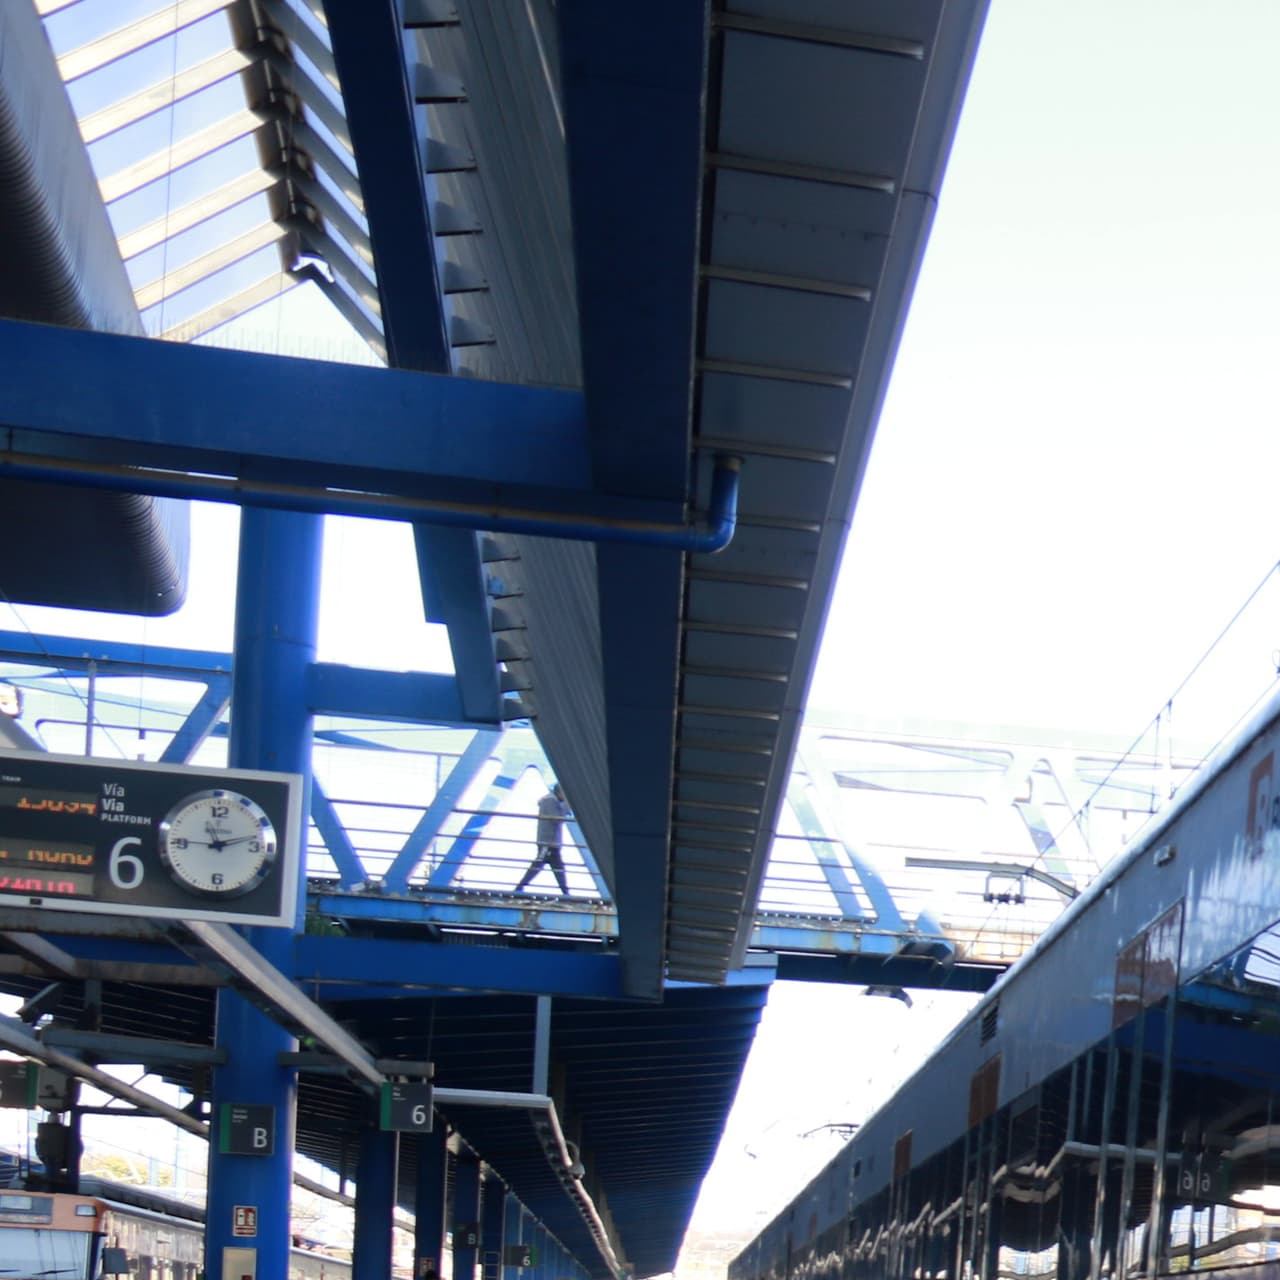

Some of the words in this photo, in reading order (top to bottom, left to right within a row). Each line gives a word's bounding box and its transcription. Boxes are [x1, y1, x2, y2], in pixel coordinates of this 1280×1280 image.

[101, 812, 152, 825] PLATFORM
[210, 806, 229, 818] 12
[248, 841, 260, 853] 3
[109, 836, 145, 890] 6
[211, 873, 224, 885] 6
[412, 1104, 426, 1125] 6
[253, 1127, 268, 1148] B
